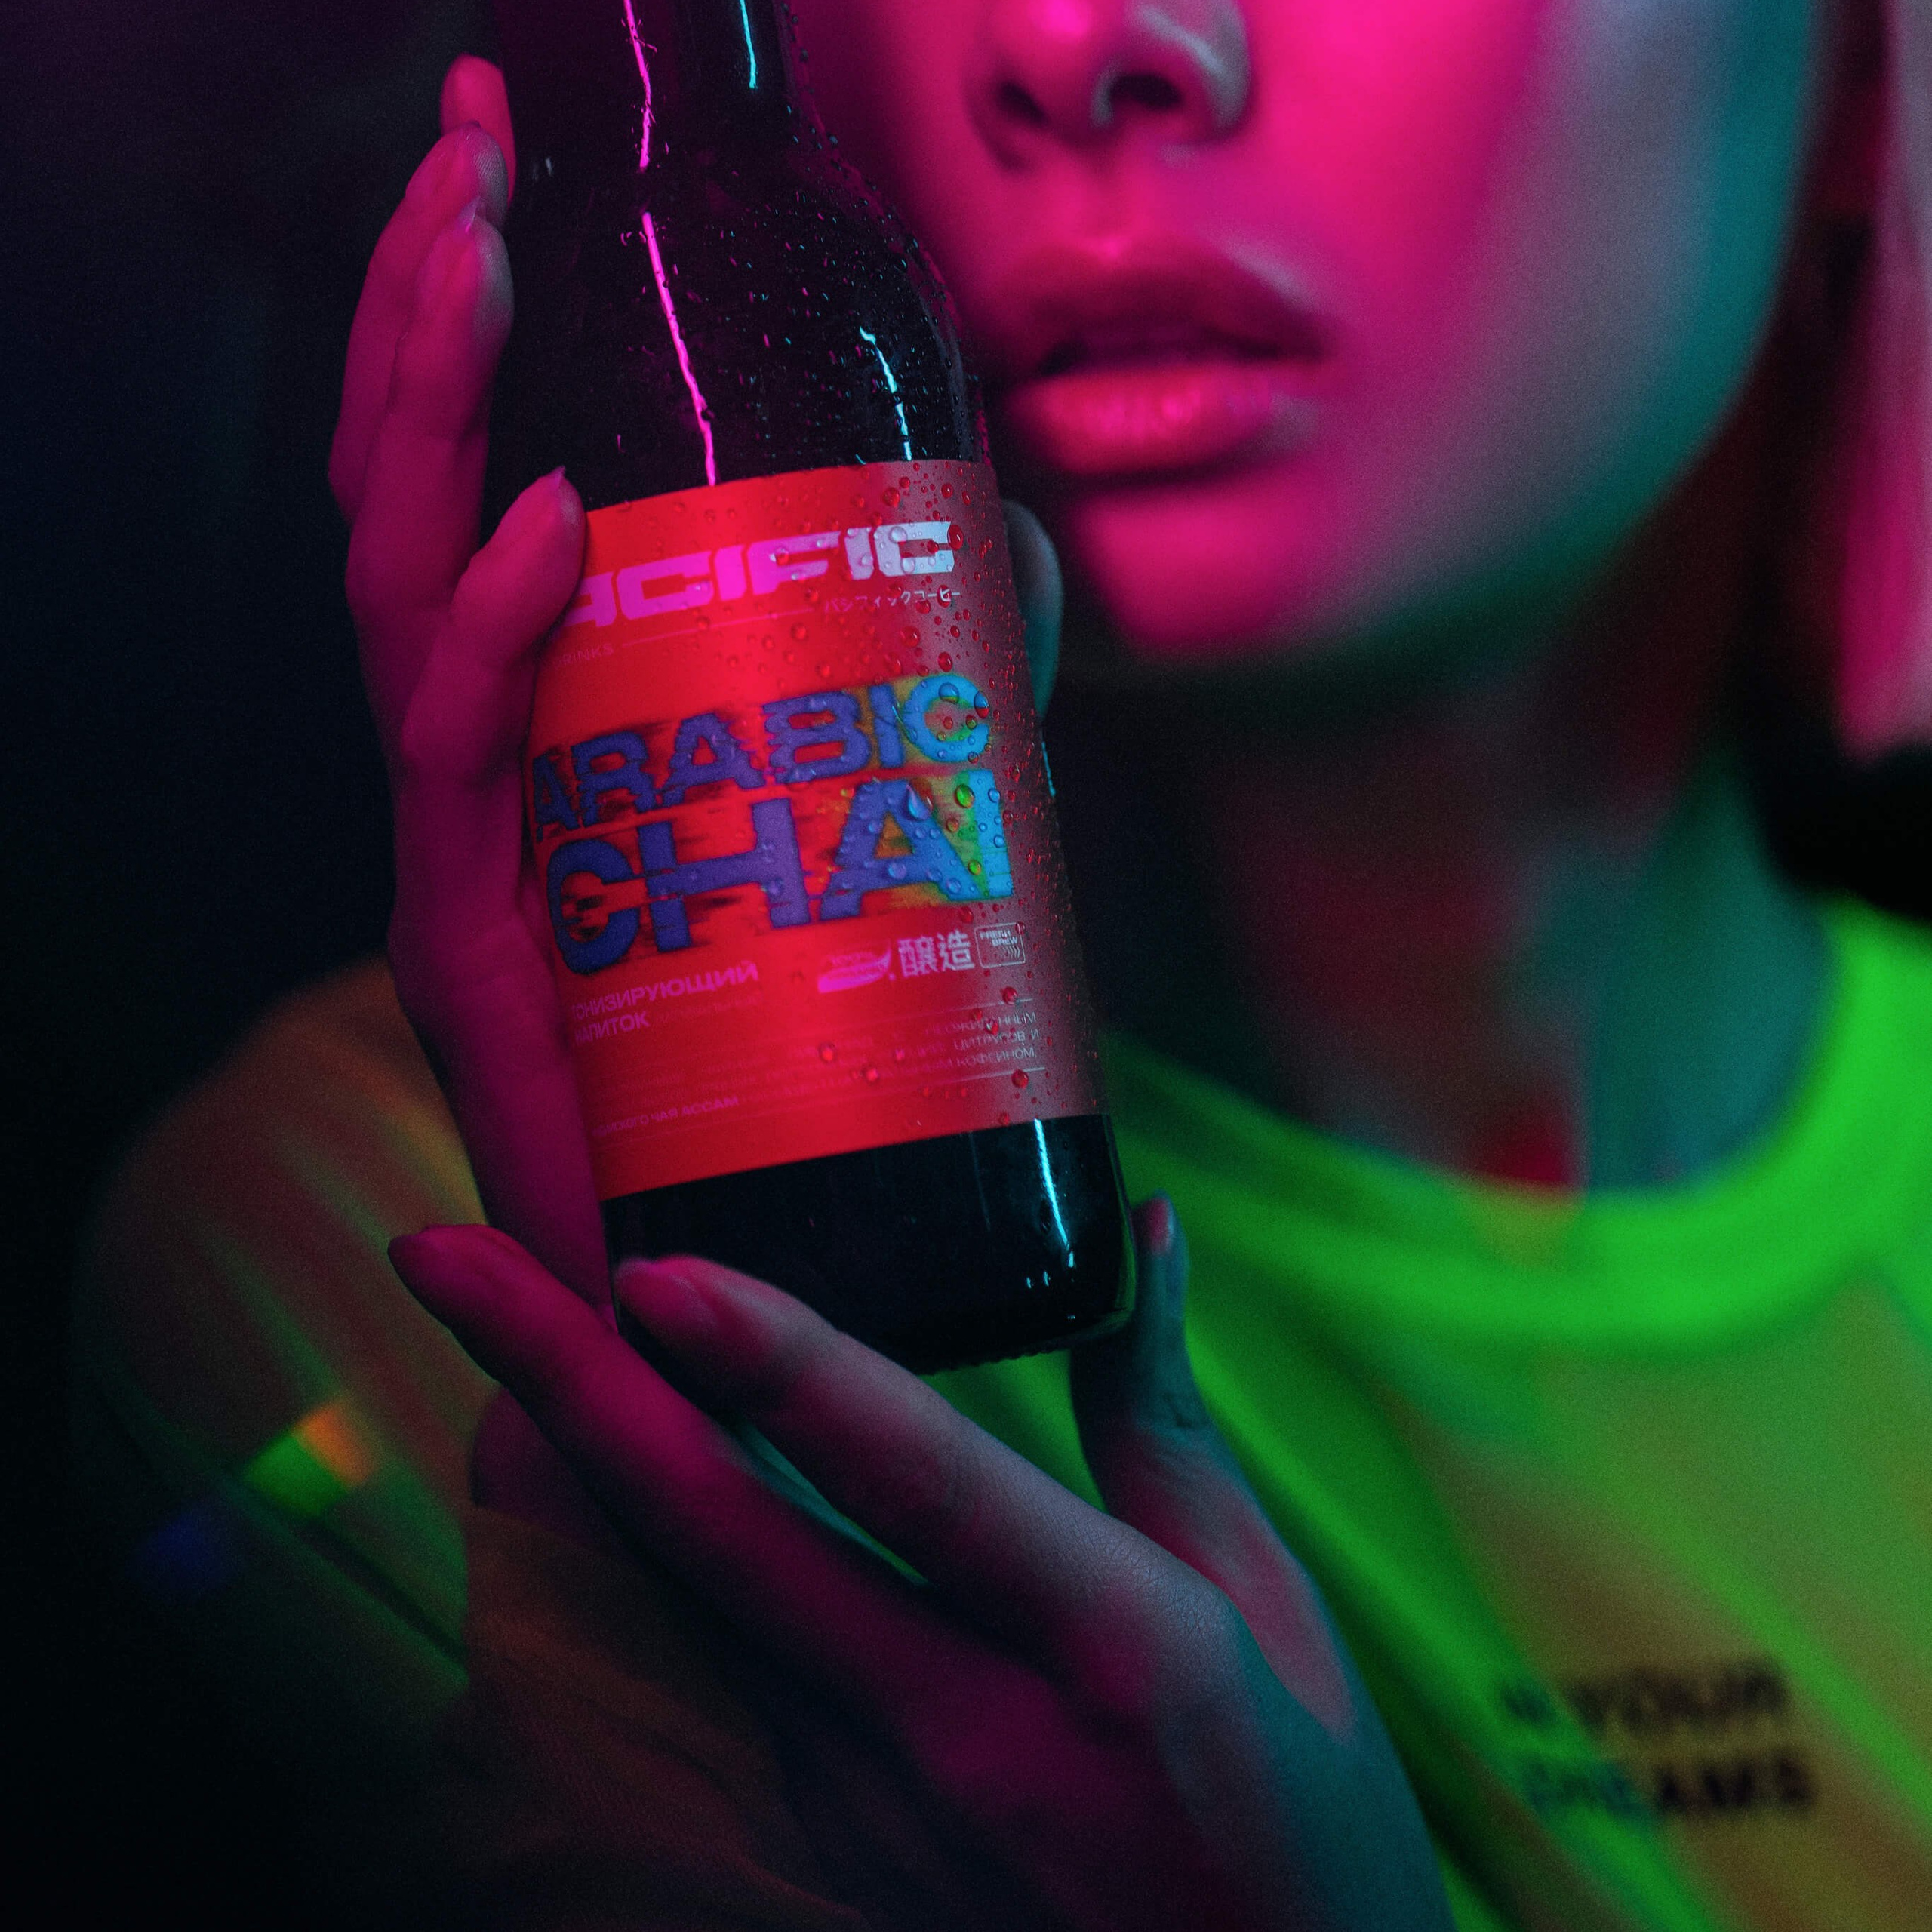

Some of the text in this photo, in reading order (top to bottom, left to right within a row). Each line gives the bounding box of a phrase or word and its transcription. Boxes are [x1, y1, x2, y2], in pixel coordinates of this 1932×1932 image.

[532, 674, 991, 842] ARABIC
[546, 768, 1014, 975] CHAI
[681, 1095, 740, 1116] АССАМ
